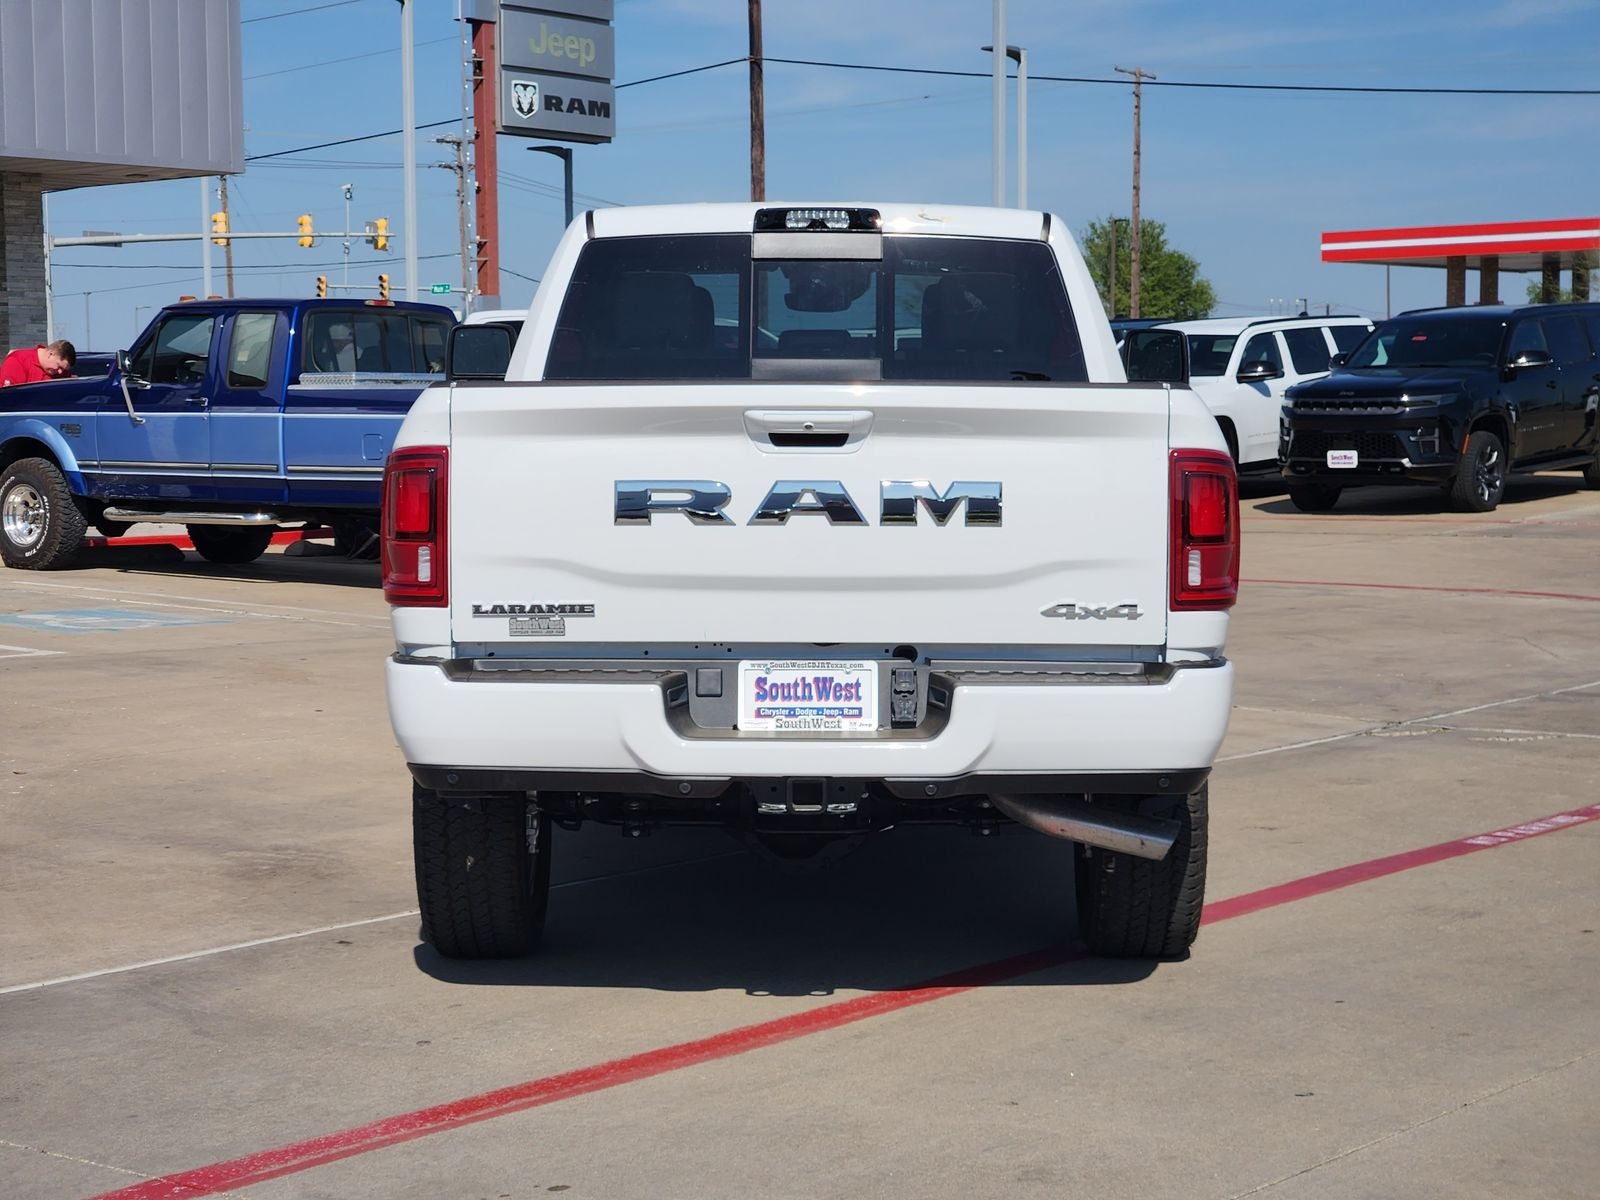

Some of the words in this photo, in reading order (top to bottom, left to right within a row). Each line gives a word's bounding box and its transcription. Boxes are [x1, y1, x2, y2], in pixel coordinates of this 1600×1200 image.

[528, 22, 596, 67] Jeep
[544, 94, 610, 118] RAM
[614, 480, 1002, 527] RAM
[472, 604, 594, 616] LARAMIE
[1040, 604, 1144, 620] 4x4
[755, 676, 862, 702] SouthWest
[760, 708, 789, 717] Chrysler
[795, 708, 817, 717] Dodge
[823, 708, 839, 717] Jeep
[775, 718, 841, 729] SouthWest
